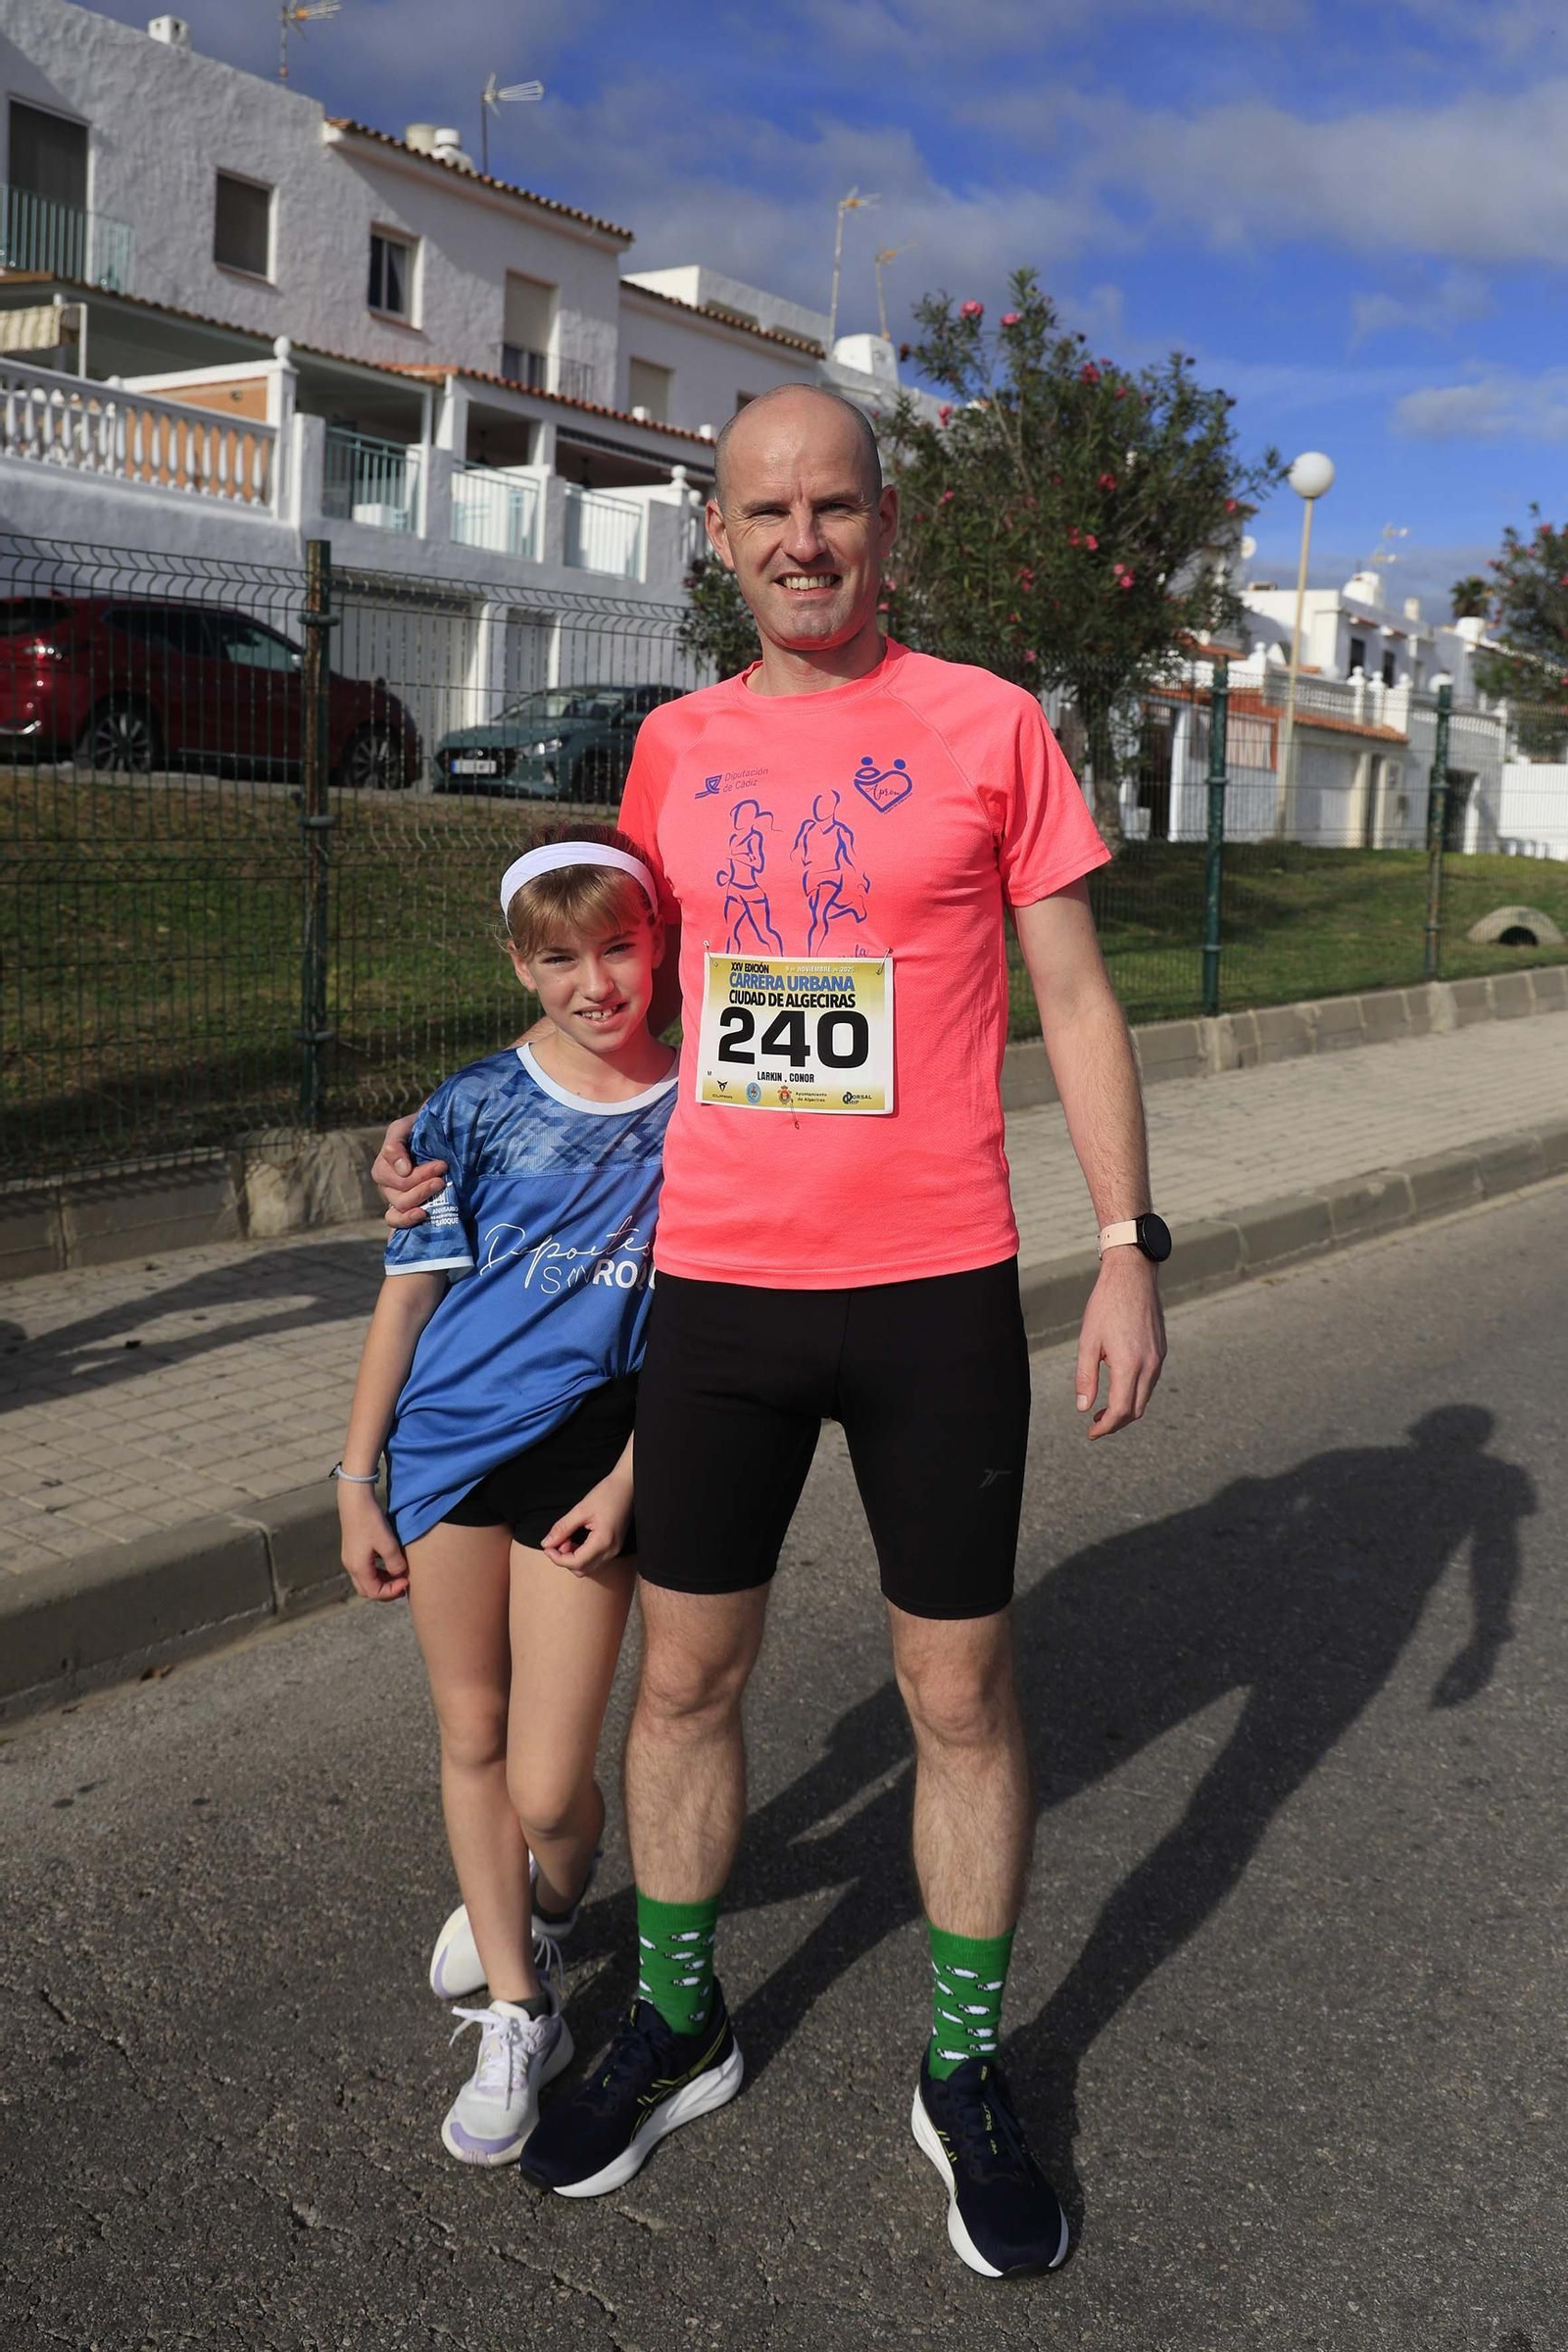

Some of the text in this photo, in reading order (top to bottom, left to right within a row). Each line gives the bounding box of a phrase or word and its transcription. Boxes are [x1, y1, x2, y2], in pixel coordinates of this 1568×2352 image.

[730, 961, 769, 973] XXV EDICIÓN
[729, 971, 856, 992] CARRERA URBANA
[729, 989, 856, 1008] CIUDAD DE ALGECIRAS
[717, 1005, 869, 1069] 240
[757, 1071, 782, 1082] LARKIN
[789, 1072, 814, 1083] CONOR
